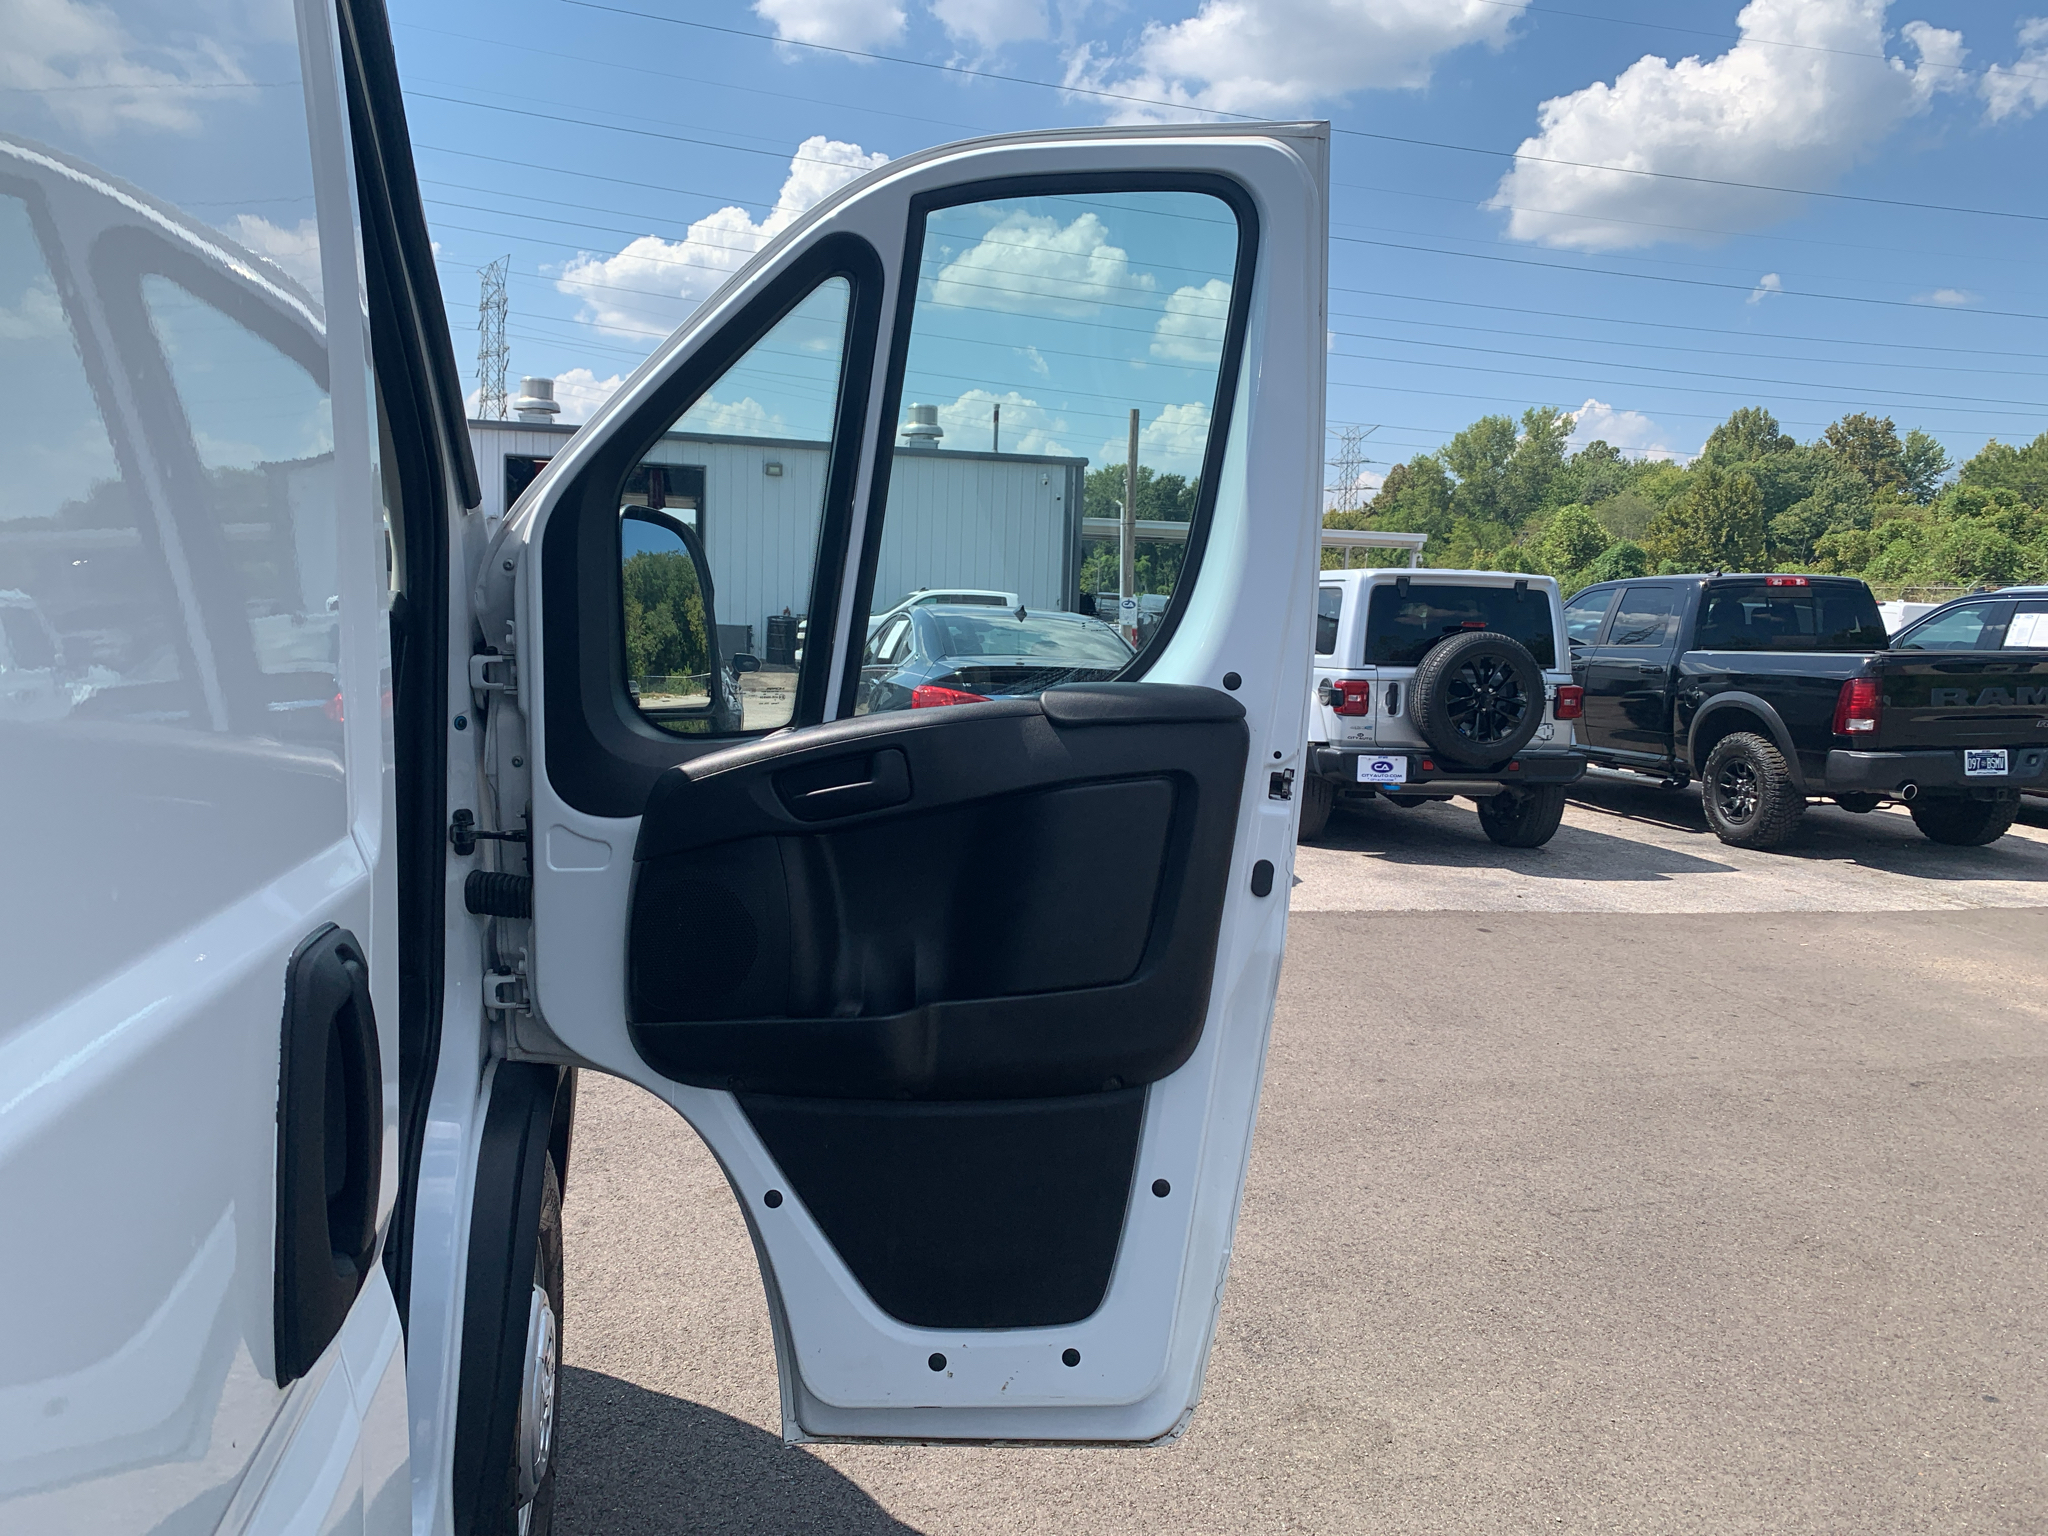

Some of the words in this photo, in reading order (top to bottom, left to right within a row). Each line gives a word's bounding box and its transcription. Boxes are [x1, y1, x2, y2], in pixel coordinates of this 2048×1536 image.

[1931, 687, 2048, 706] RAM
[1374, 763, 1390, 771] CA
[1967, 757, 1981, 769] 097
